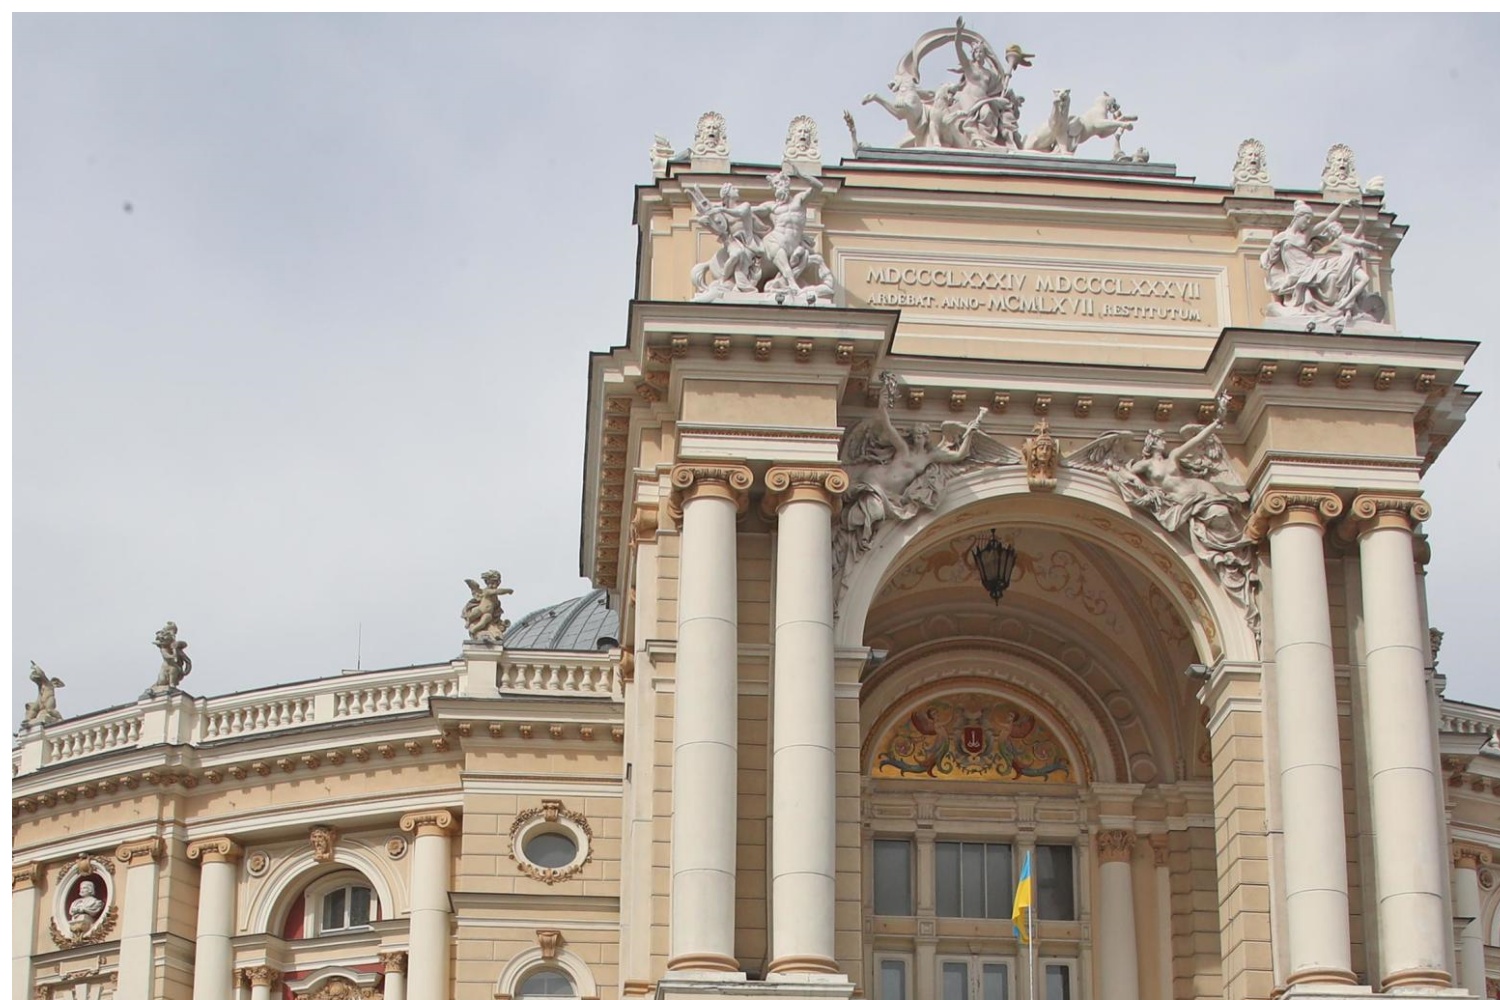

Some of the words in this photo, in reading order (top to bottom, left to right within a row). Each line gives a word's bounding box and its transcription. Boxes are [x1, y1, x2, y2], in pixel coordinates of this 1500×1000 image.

[866, 266, 1027, 291] MDCCCLXXXIV
[1035, 274, 1202, 300] MDCCCLXXXVII
[987, 294, 1094, 317] MCMLXVII
